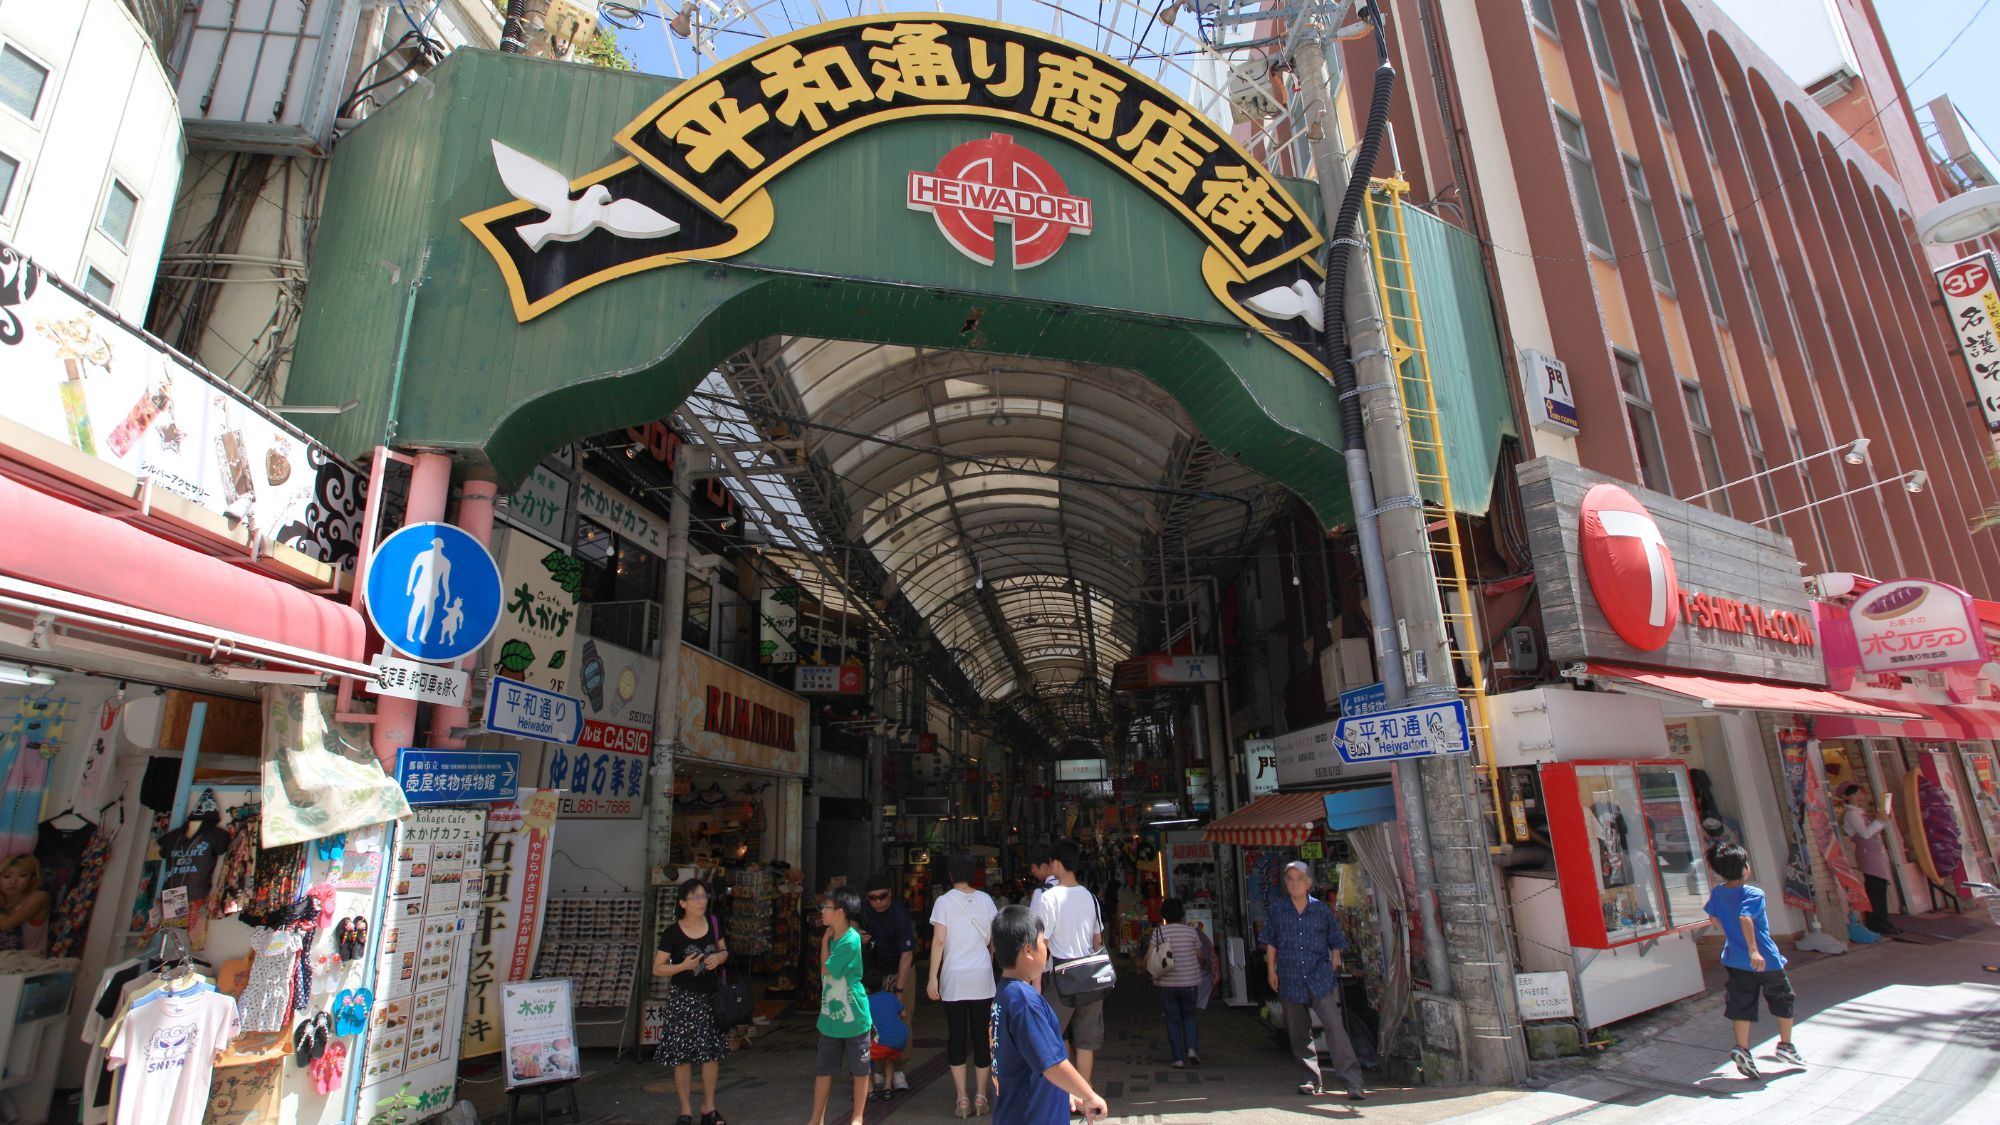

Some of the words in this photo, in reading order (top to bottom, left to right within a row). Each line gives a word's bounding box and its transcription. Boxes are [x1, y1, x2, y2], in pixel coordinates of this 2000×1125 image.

[656, 22, 1294, 257] 平和通り商店街
[913, 177, 1089, 225] HEIWADORI
[1945, 266, 1984, 294] 3F
[1545, 365, 1568, 397] 門
[1560, 415, 1578, 427] COFFEE
[580, 482, 660, 547] 木かげカフェ
[1597, 509, 1668, 627] T
[507, 582, 574, 637] 木かげ
[1679, 588, 1815, 647] T-SHIRT-YA.COM
[1889, 616, 1926, 627] お菓子の
[506, 688, 566, 722] 平和通り
[629, 710, 652, 725] SEIKO
[704, 685, 796, 752] RAMAYANA
[518, 715, 554, 734] Heiwadori
[603, 726, 649, 753] CASIO
[1359, 711, 1443, 741] 平和通り
[406, 826, 470, 841] 木かげカフェ
[416, 812, 445, 824] Kokage
[448, 814, 466, 824] Cafe
[512, 841, 542, 980] やわらかさと旨みが際立ちま
